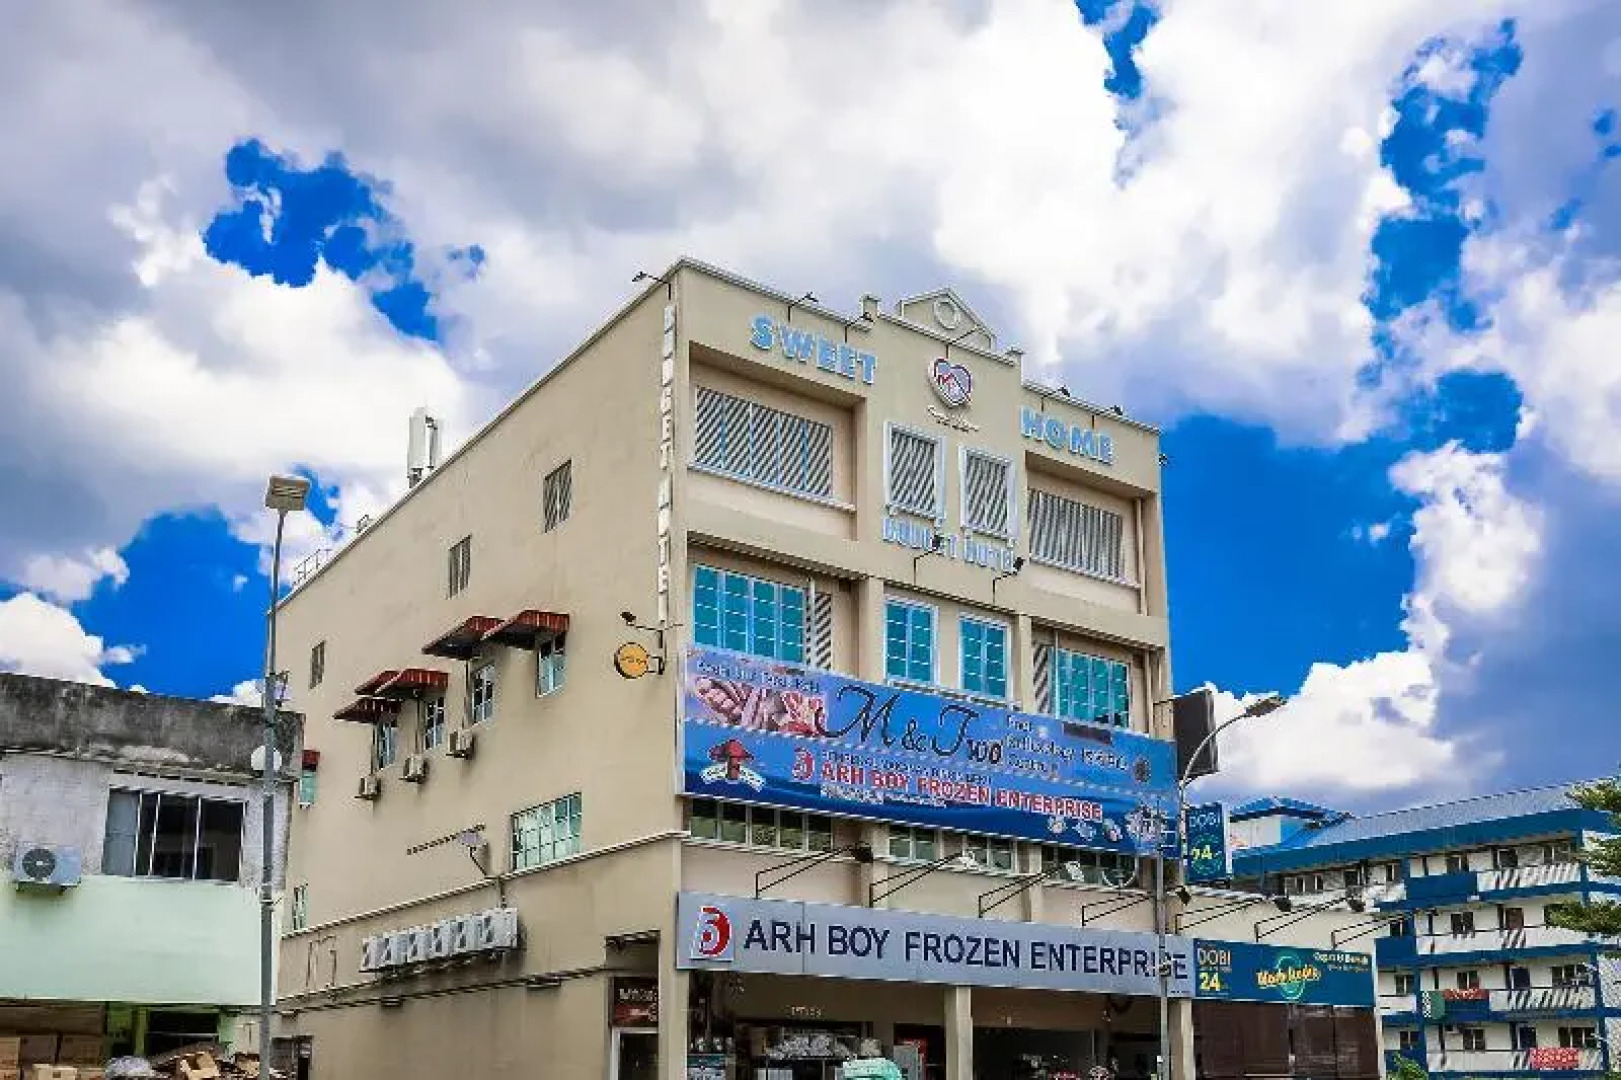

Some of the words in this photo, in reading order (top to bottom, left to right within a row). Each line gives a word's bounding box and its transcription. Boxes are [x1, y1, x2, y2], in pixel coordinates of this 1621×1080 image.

[749, 313, 878, 384] SWEET
[1020, 404, 1114, 466] HOME
[901, 718, 927, 752] &
[822, 761, 866, 785] ARH
[870, 769, 910, 794] BOY
[916, 776, 992, 808] FROZEN
[994, 787, 1103, 824] ENTERPRISE
[743, 919, 816, 955] ARH
[827, 924, 891, 960] BOY
[904, 931, 1020, 969] FROZEN
[1196, 948, 1231, 967] DOBI
[1199, 971, 1221, 992] 24
